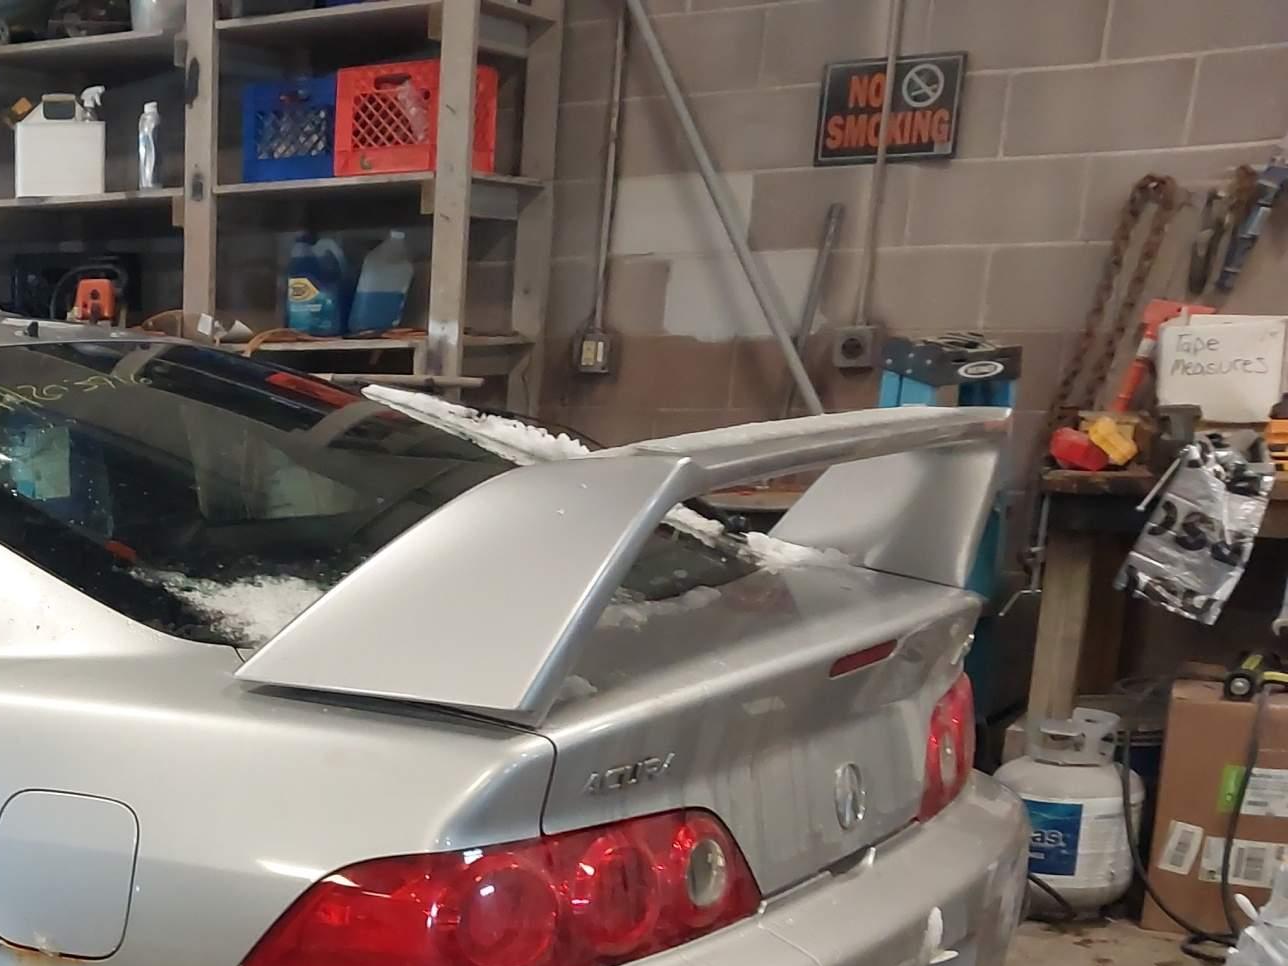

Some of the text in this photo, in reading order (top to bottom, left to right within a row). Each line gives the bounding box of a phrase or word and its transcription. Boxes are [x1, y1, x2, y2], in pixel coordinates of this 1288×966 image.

[848, 73, 887, 108] NO
[825, 109, 951, 149] SMOKING
[1175, 333, 1220, 357] Tape
